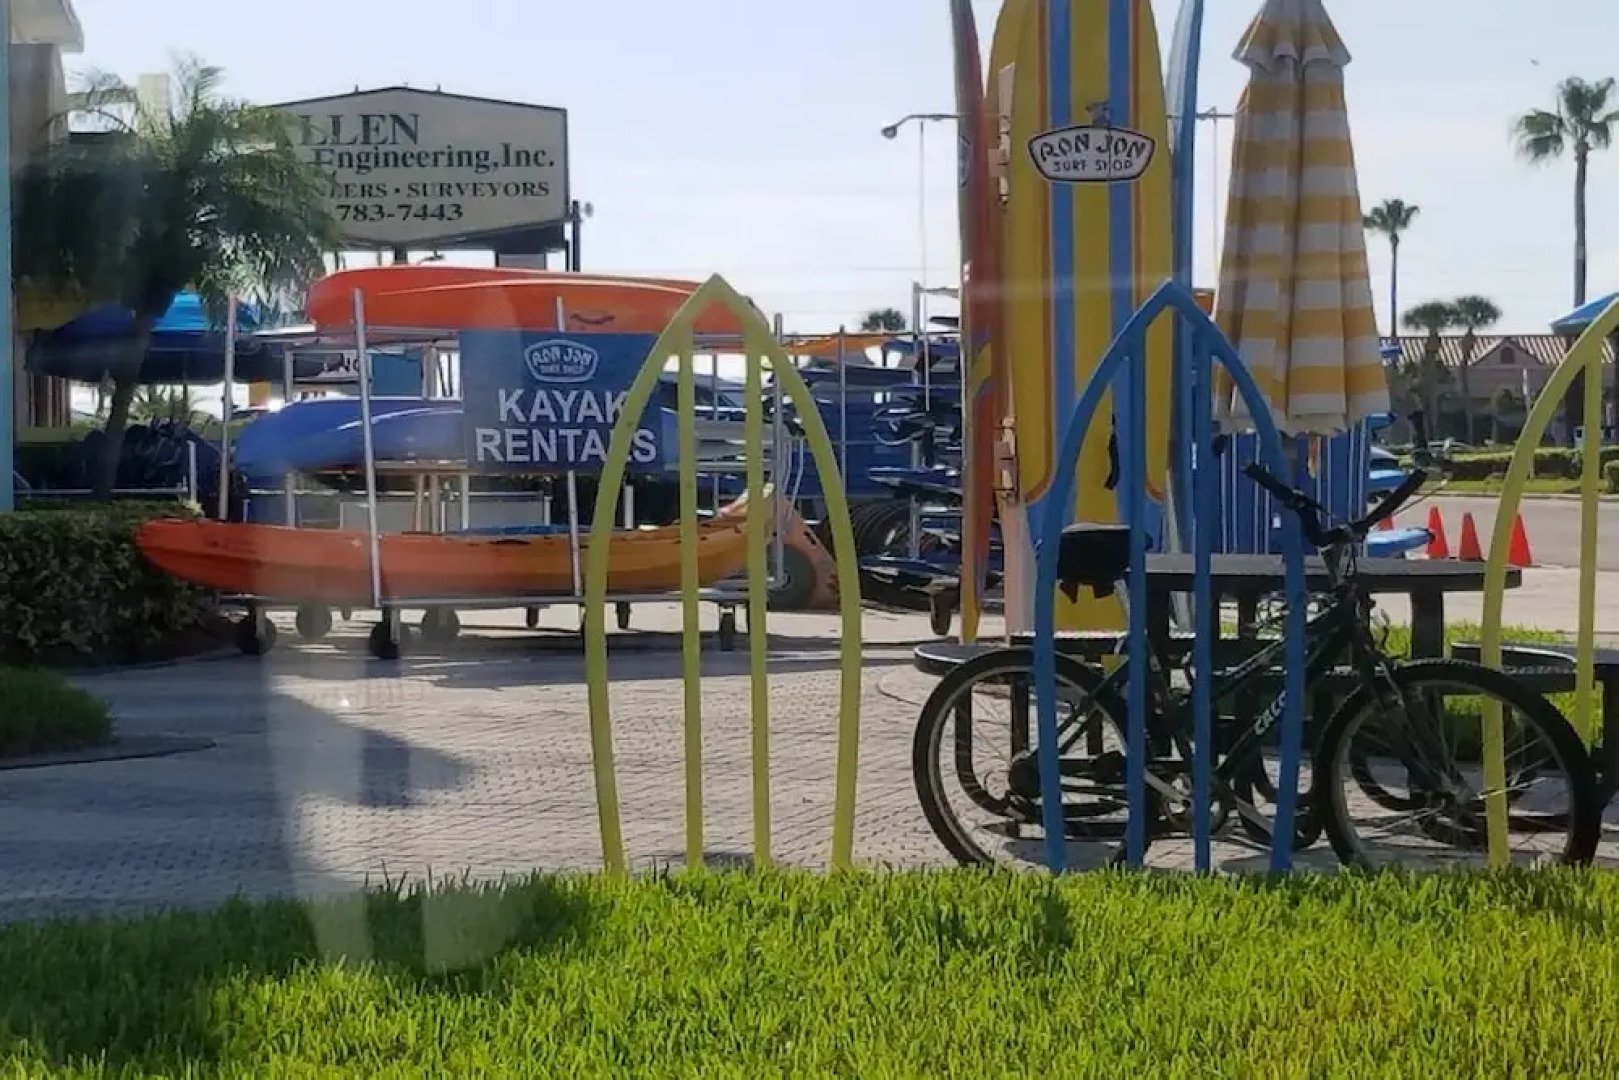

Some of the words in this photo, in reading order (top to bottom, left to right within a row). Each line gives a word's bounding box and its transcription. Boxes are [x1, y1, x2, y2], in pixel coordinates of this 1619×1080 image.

[1040, 132, 1090, 162] RON
[1095, 135, 1147, 159] JON
[1053, 159, 1088, 172] SURF
[1095, 159, 1133, 172] SHOP
[406, 182, 550, 198] SURVEYORS
[336, 203, 464, 222] 783-7443
[498, 387, 628, 424] KAYAK
[475, 427, 657, 463] RENTAS
